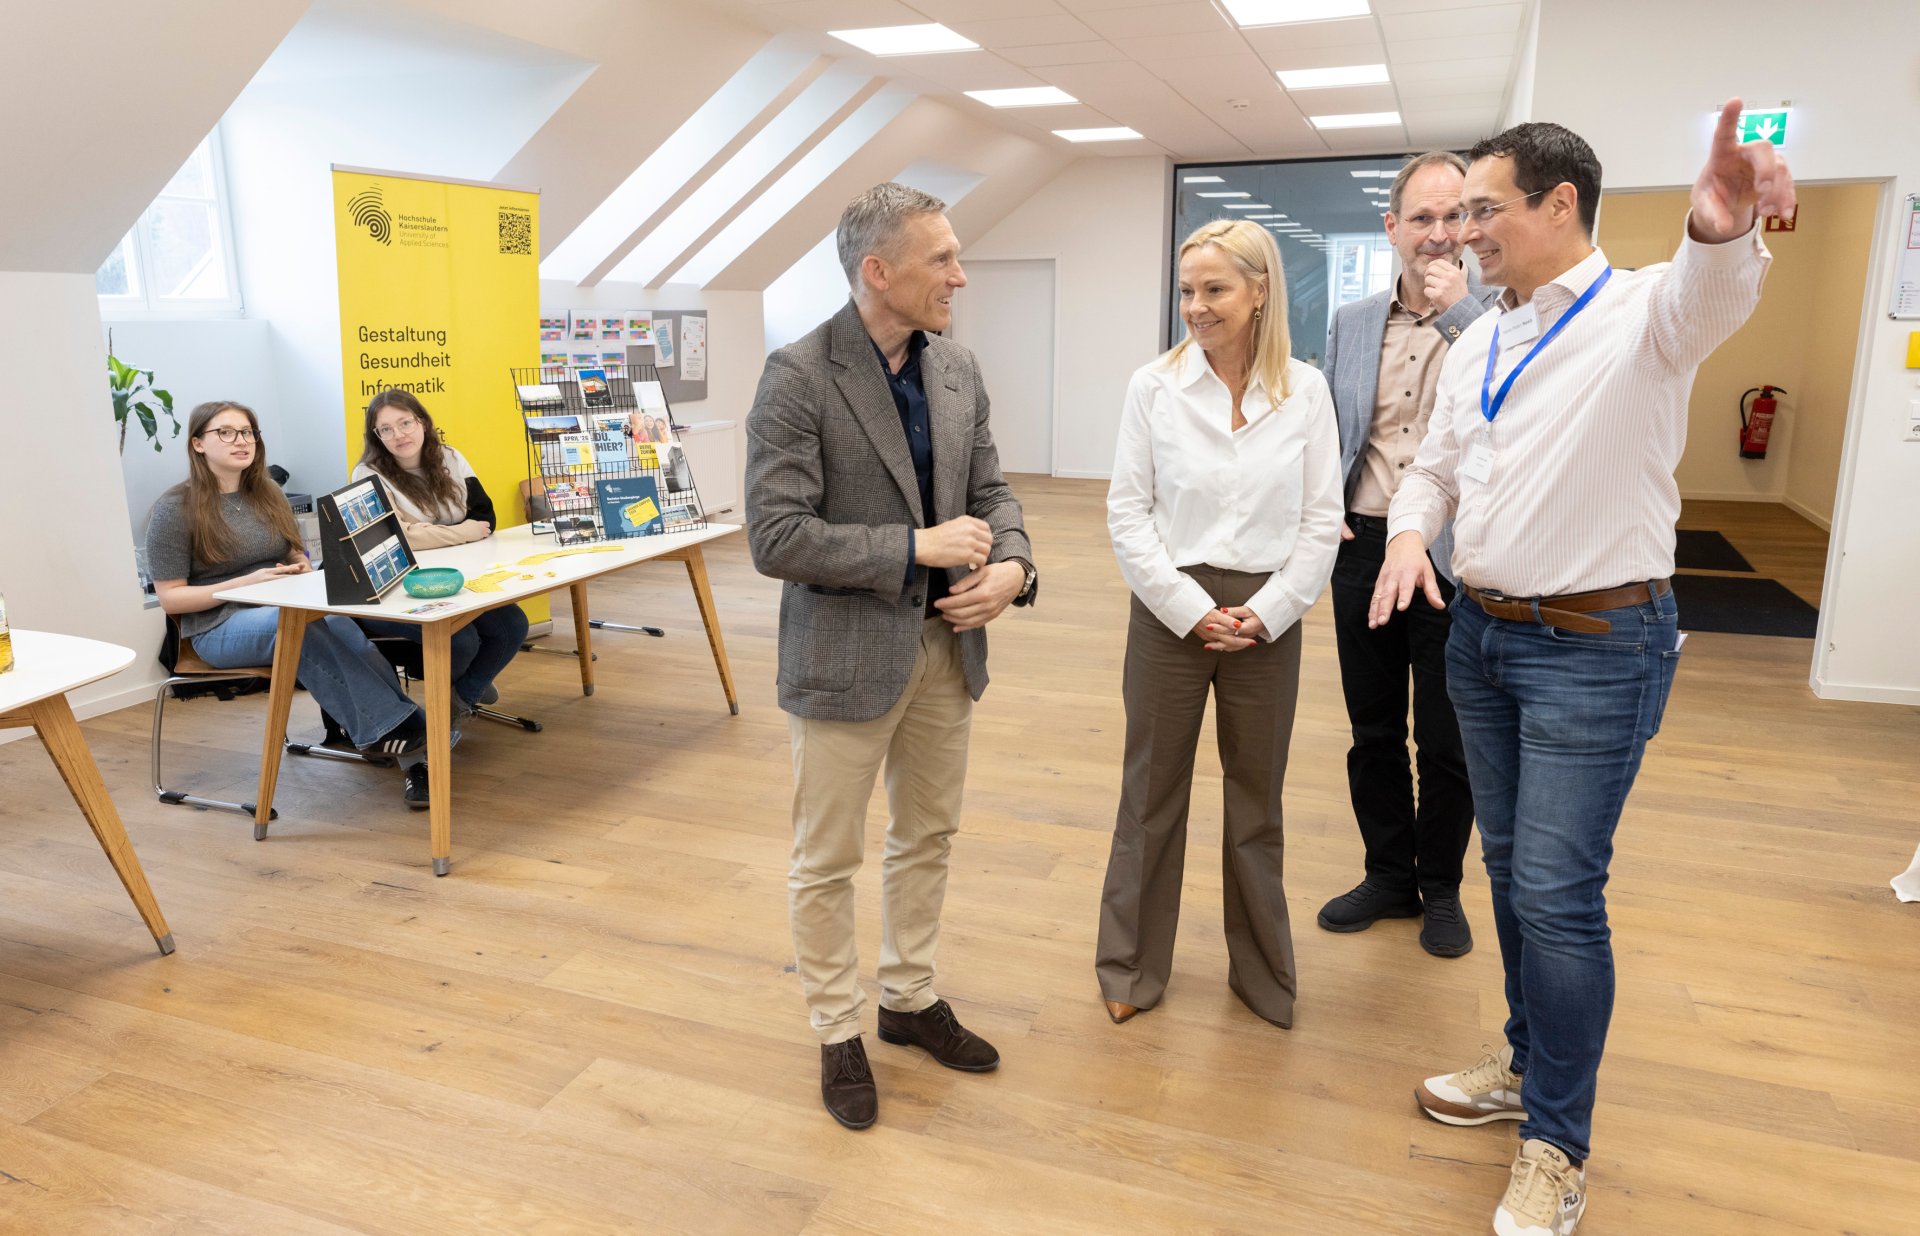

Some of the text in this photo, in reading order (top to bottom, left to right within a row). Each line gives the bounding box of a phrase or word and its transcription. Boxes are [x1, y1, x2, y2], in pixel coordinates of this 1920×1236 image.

[398, 214, 437, 223] Hochschule
[399, 222, 449, 232] Kaiserslautern
[400, 231, 428, 241] University
[400, 239, 449, 249] Applied Sciences
[358, 325, 447, 347] Gestaltung
[360, 351, 451, 369] Gesundheit
[1543, 1149, 1560, 1162] FILA
[1563, 1194, 1579, 1208] FILA
